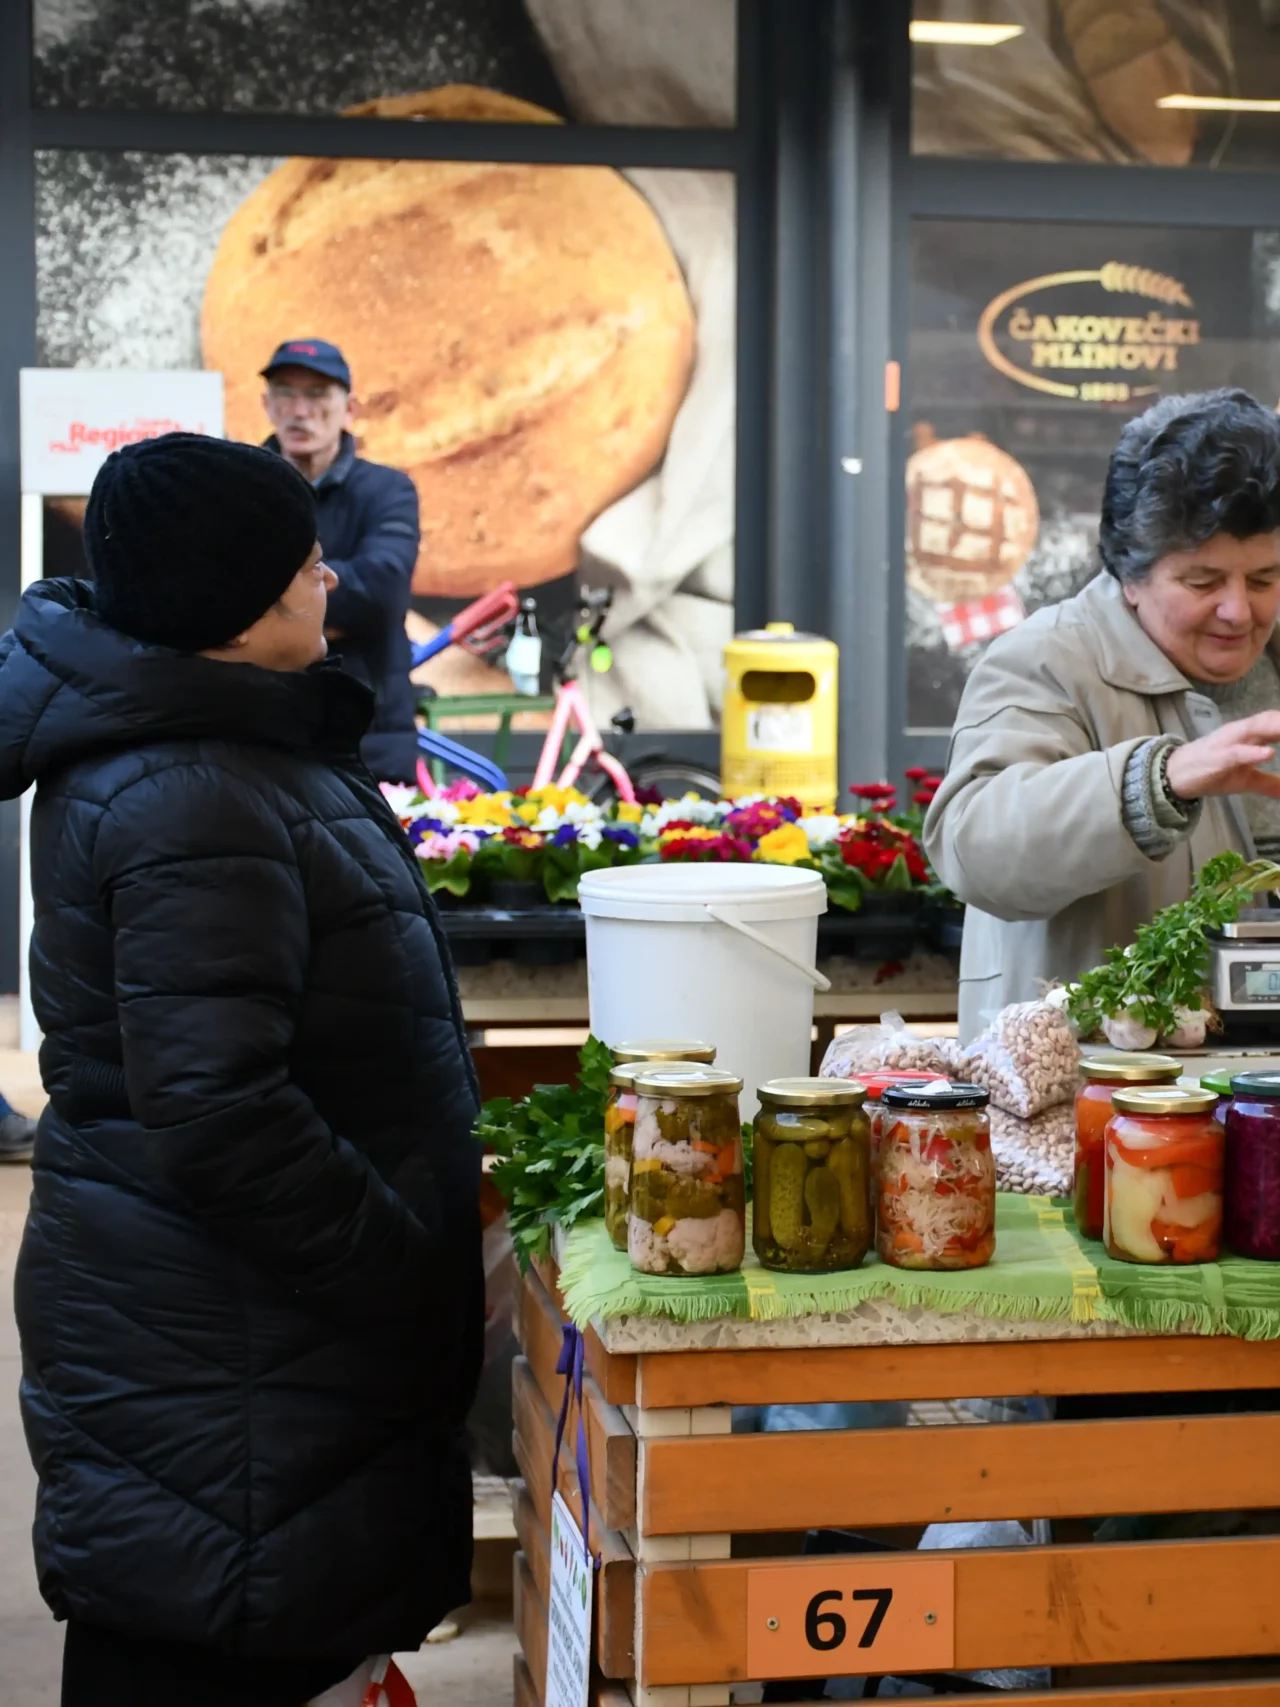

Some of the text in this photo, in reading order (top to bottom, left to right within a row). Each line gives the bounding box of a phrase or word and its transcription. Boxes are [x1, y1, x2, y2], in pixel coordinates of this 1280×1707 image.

[1009, 308, 1200, 343] ČAKOVEČKI
[1032, 342, 1178, 370] MLINOVI
[804, 1587, 894, 1651] 67
